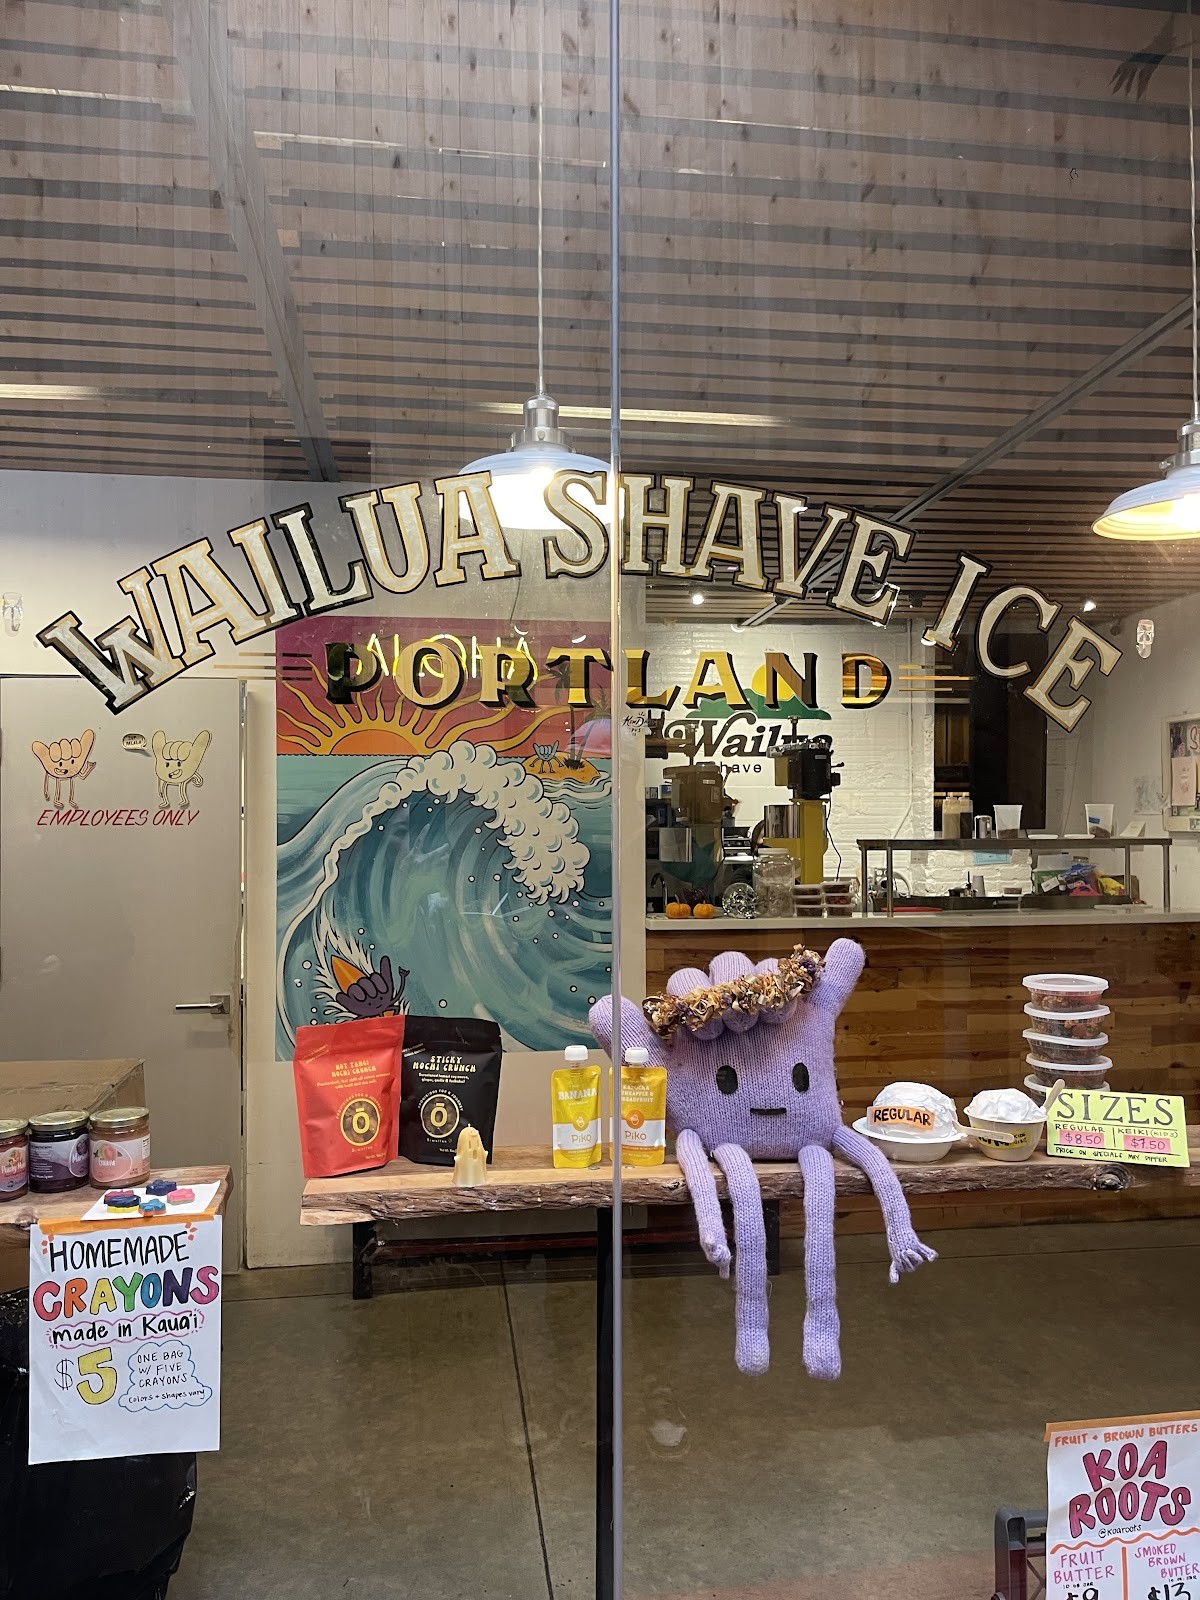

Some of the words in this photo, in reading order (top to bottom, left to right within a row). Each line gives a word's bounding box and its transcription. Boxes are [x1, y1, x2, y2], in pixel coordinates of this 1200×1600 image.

[37, 470, 521, 715] WAILUA
[543, 470, 916, 627] SHAVE
[921, 550, 1122, 733] ICE
[325, 641, 892, 711] PORTLAND
[37, 809, 149, 826] EMPLOYEES
[152, 809, 200, 826] ONLY
[412, 1061, 440, 1071] MOCHI
[443, 1063, 477, 1073] CRUNCH
[430, 1055, 463, 1064] STICKY
[557, 1088, 598, 1101] BANANA
[873, 1108, 932, 1126] REGULAR
[1056, 1092, 1174, 1126] SIZES
[624, 1130, 647, 1140] Piko
[1055, 1123, 1106, 1133] REGULAR
[571, 1133, 592, 1143] Piko
[1065, 1132, 1102, 1144] $8.50
[1055, 1146, 1074, 1154] PRICE
[50, 1230, 190, 1273] HOMEMADE
[33, 1265, 220, 1321] CRAYONS
[52, 1321, 108, 1345] made
[118, 1323, 132, 1338] in
[137, 1352, 157, 1363] ONE
[163, 1349, 184, 1360] BAG
[156, 1362, 182, 1376] FIVE
[138, 1372, 188, 1388] CRAYONS
[161, 1391, 187, 1400] shapes
[188, 1389, 205, 1399] vary
[1054, 1432, 1088, 1447] FRUIT
[1103, 1428, 1144, 1443] BROWN
[1149, 1423, 1198, 1437] BUTTERS
[1082, 1440, 1168, 1492] KOA
[1068, 1481, 1192, 1539] ROOTS
[1060, 1549, 1105, 1568] FRUIT
[1134, 1543, 1177, 1558] SMOKED
[1148, 1553, 1186, 1568] BROWN
[1053, 1565, 1115, 1584] BUTTER
[1160, 1562, 1200, 1579] BUTTER
